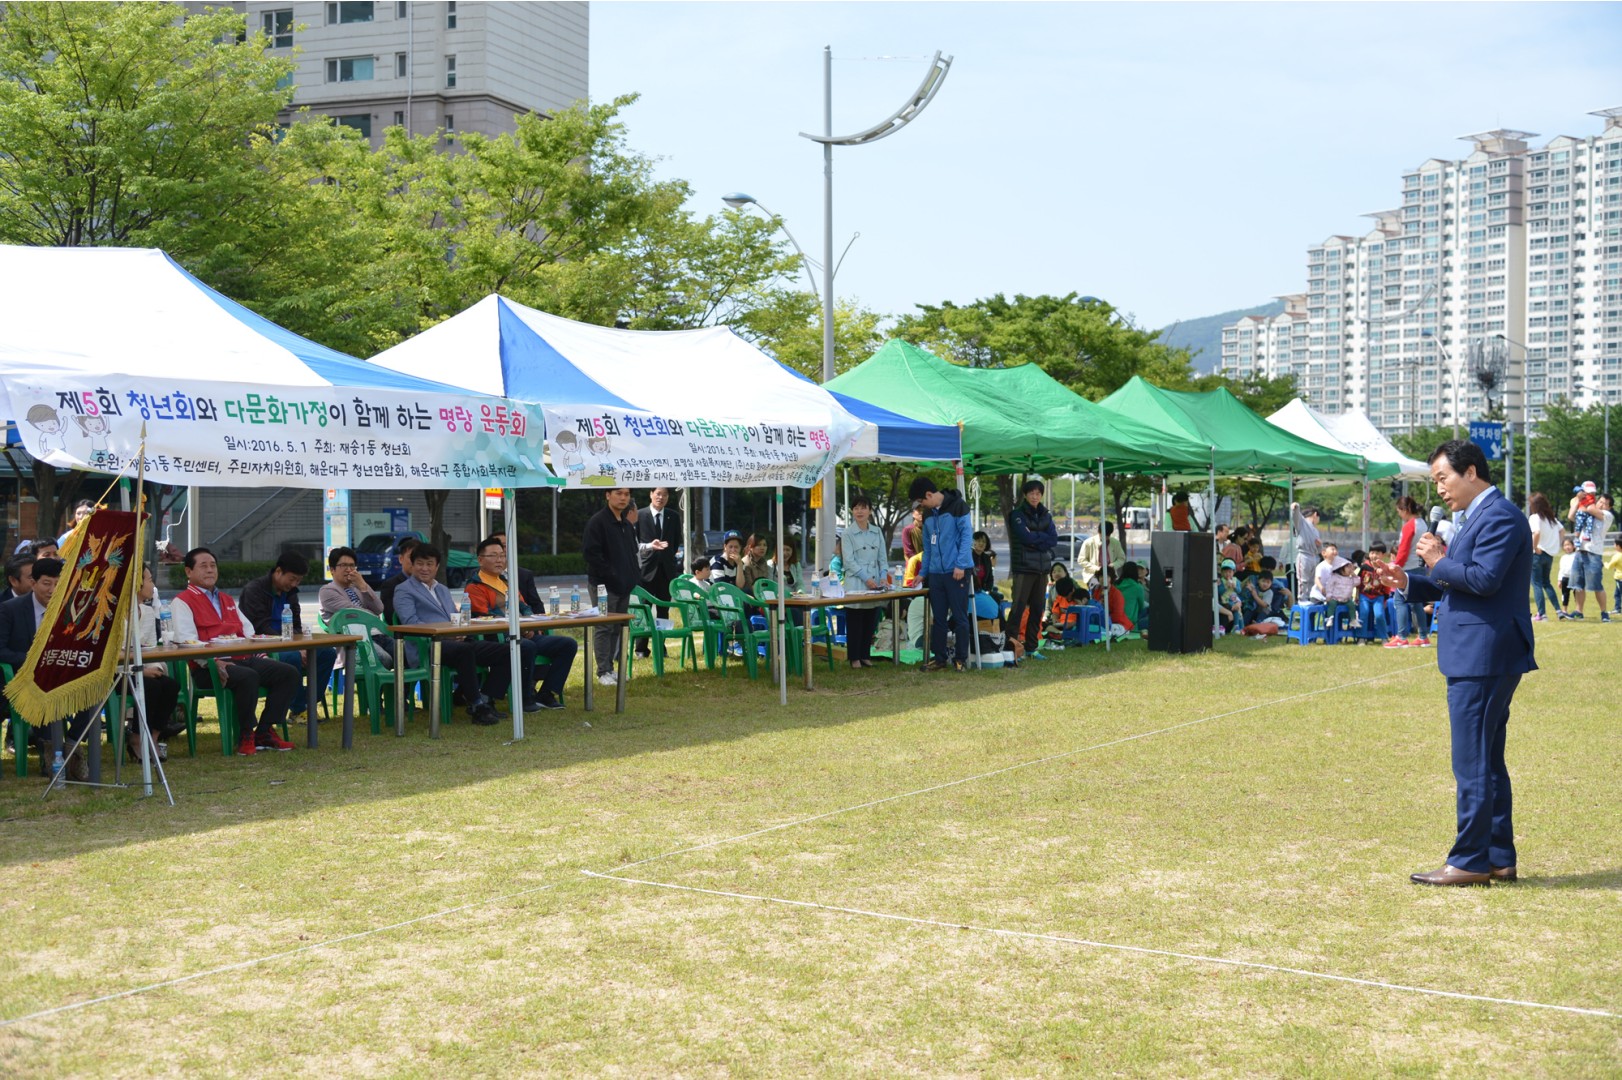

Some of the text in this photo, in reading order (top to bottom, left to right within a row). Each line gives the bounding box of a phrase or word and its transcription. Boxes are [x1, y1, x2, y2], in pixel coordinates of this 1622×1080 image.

[56, 386, 526, 437] 제5회 청년회와 다문화가정이 함께 하는 명랑 운동회
[314, 439, 336, 454] 주최:
[339, 439, 377, 456] 재송1동
[381, 442, 411, 457] 청년회
[576, 413, 621, 437] 제5회
[623, 414, 684, 438] 청년회와
[686, 417, 760, 443] 다문화가정이
[760, 422, 784, 446] 함께
[787, 425, 807, 448] 하는
[810, 429, 831, 451] 명랑
[94, 452, 124, 471] 후원:
[173, 456, 222, 475] 주민센터,
[228, 459, 307, 477] 주민자치위원회,
[310, 460, 349, 477] 해운대구
[352, 462, 408, 478] 청년연합회,
[410, 462, 450, 478] 해운대구
[452, 463, 517, 478] 종합사회복지관
